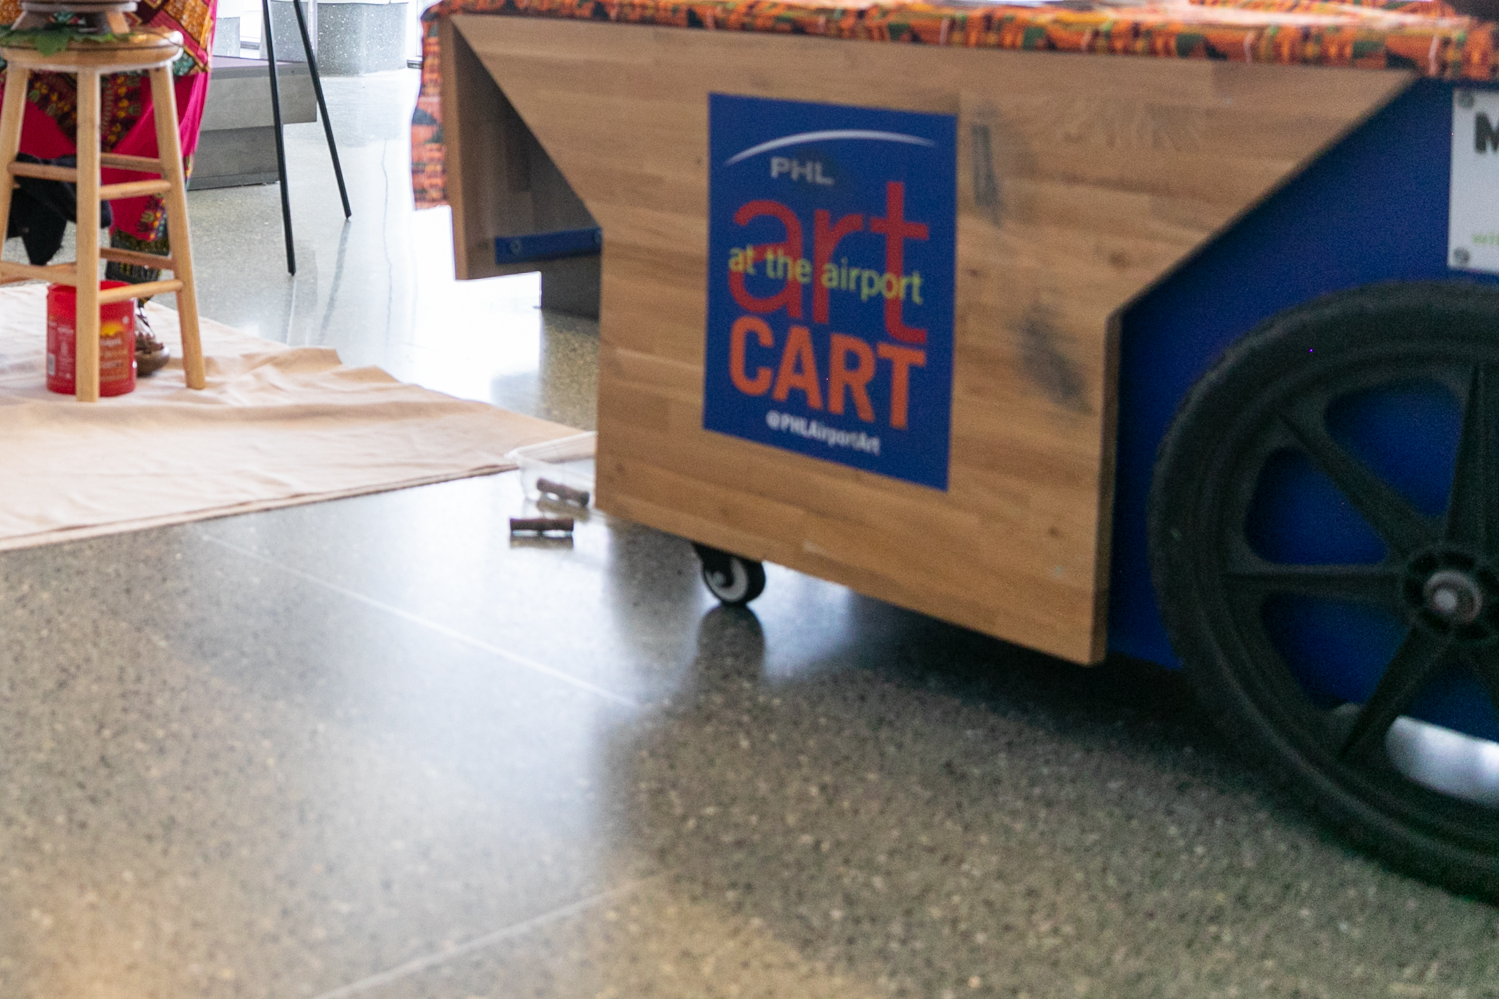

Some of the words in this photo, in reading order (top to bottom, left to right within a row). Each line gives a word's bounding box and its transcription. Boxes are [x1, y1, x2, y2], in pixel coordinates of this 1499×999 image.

[770, 156, 836, 187] PHL
[728, 243, 757, 276] at
[765, 248, 813, 285] the
[820, 256, 924, 305] airport
[729, 180, 930, 344] art
[728, 315, 927, 431] CART
[765, 409, 881, 457] @PHLAirportArt
